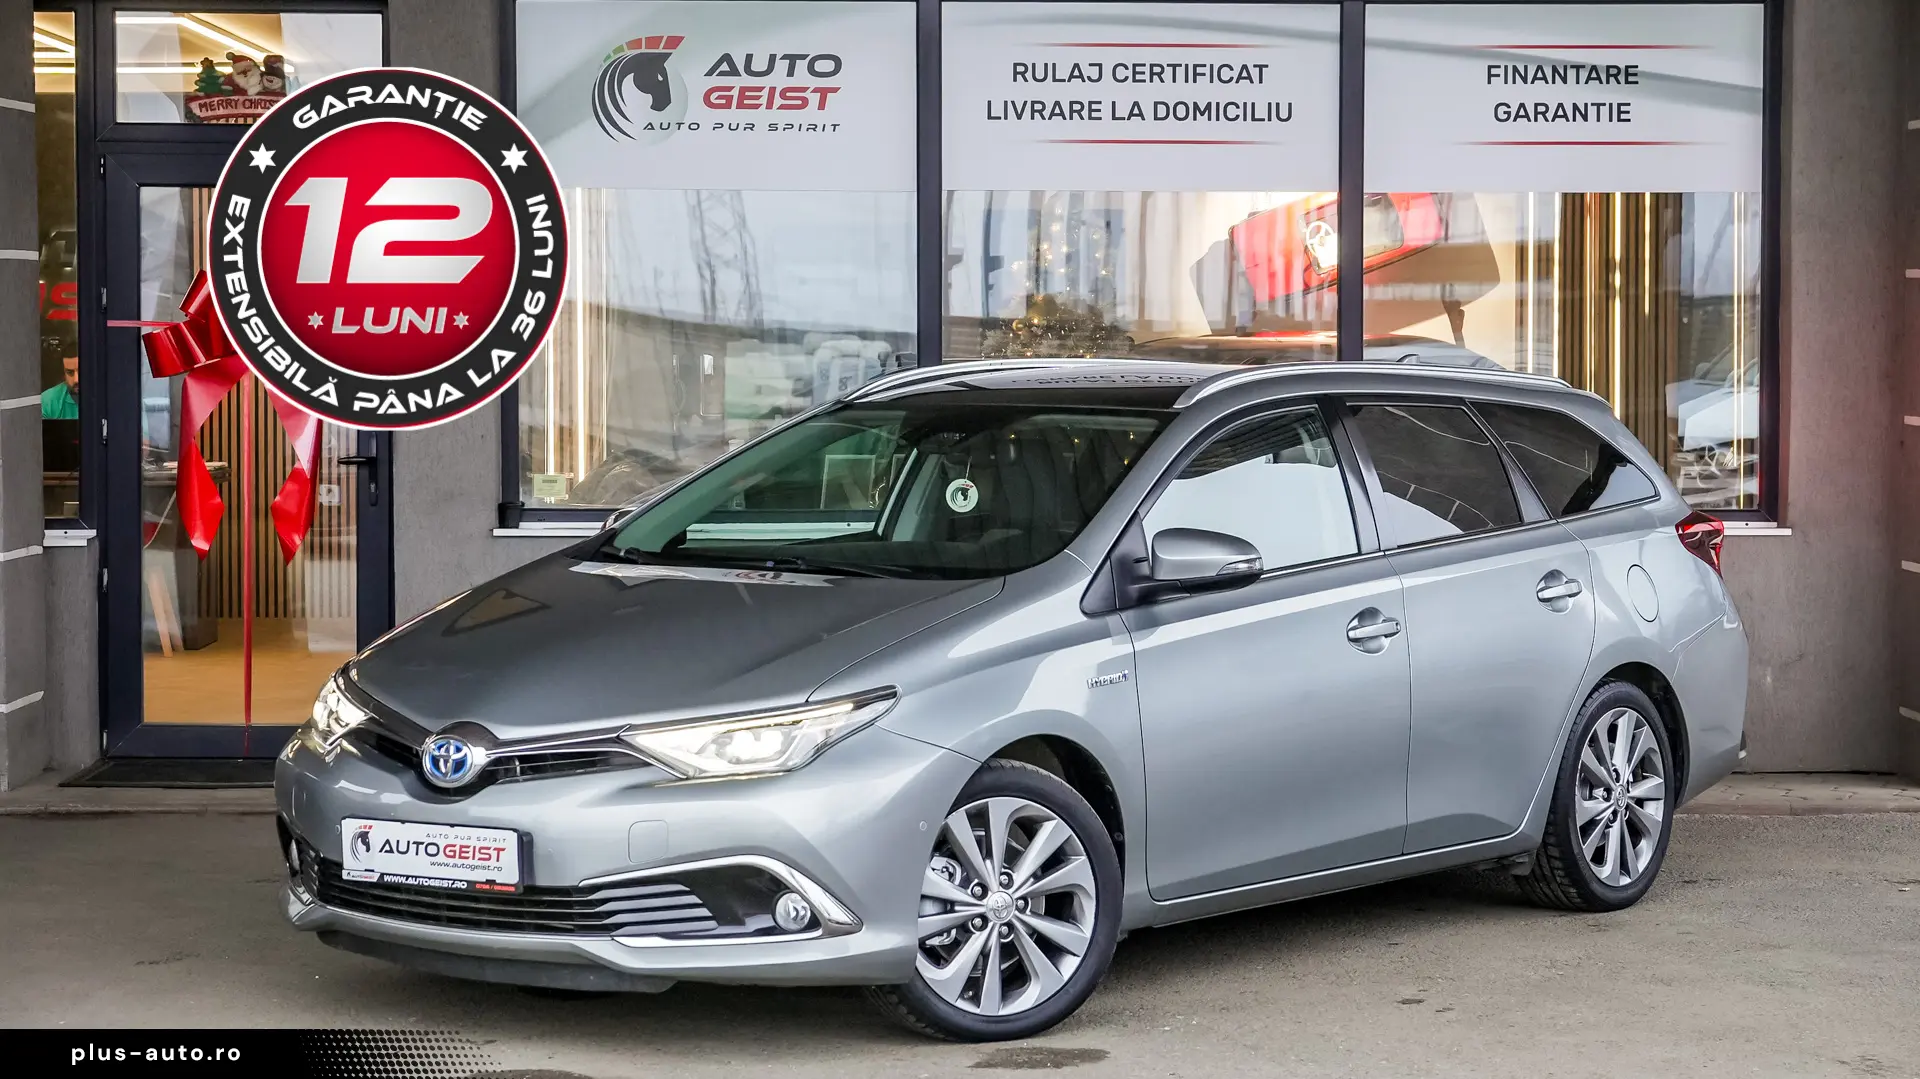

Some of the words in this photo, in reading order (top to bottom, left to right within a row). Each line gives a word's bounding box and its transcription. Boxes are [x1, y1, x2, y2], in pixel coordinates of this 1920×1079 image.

[703, 52, 843, 78] AUTO
[1012, 62, 1103, 83] RULAJ
[1111, 63, 1269, 84] CERTIFICAT
[1487, 65, 1639, 85] FINANTARE
[198, 98, 240, 113] MERRY
[242, 98, 279, 110] CHRIS
[702, 85, 842, 111] GEIST
[986, 100, 1103, 121] LIVRARE
[1111, 101, 1146, 121] LA
[1153, 101, 1293, 122] DOMICILIU
[1492, 102, 1632, 123] GARANTIE
[643, 121, 701, 131] AUTO
[712, 122, 755, 132] PUR
[767, 123, 841, 133] SPIRIT
[429, 861, 503, 872] www.autogeist.ro
[383, 875, 467, 888] WWW.AUTOGEIST.RO
